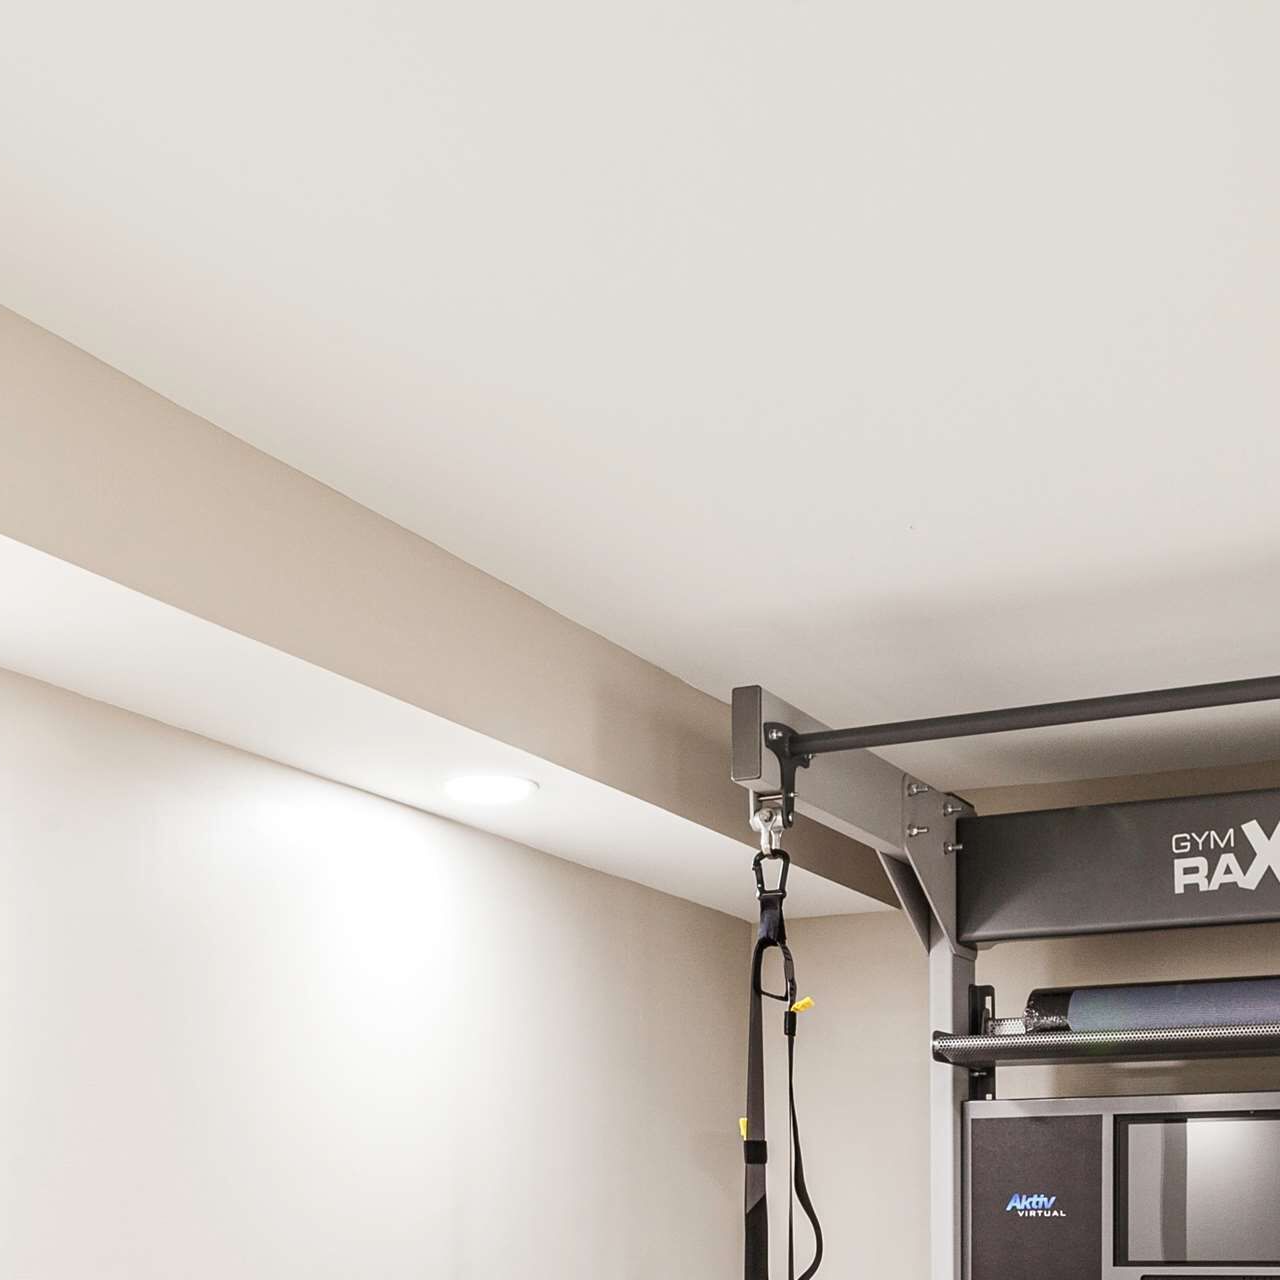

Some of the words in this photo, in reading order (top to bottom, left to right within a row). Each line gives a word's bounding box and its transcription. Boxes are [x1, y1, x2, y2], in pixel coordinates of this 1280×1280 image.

[1172, 828, 1235, 853] GYM
[1006, 1193, 1057, 1211] Aktiv
[1017, 1209, 1067, 1217] VIRTUAL
